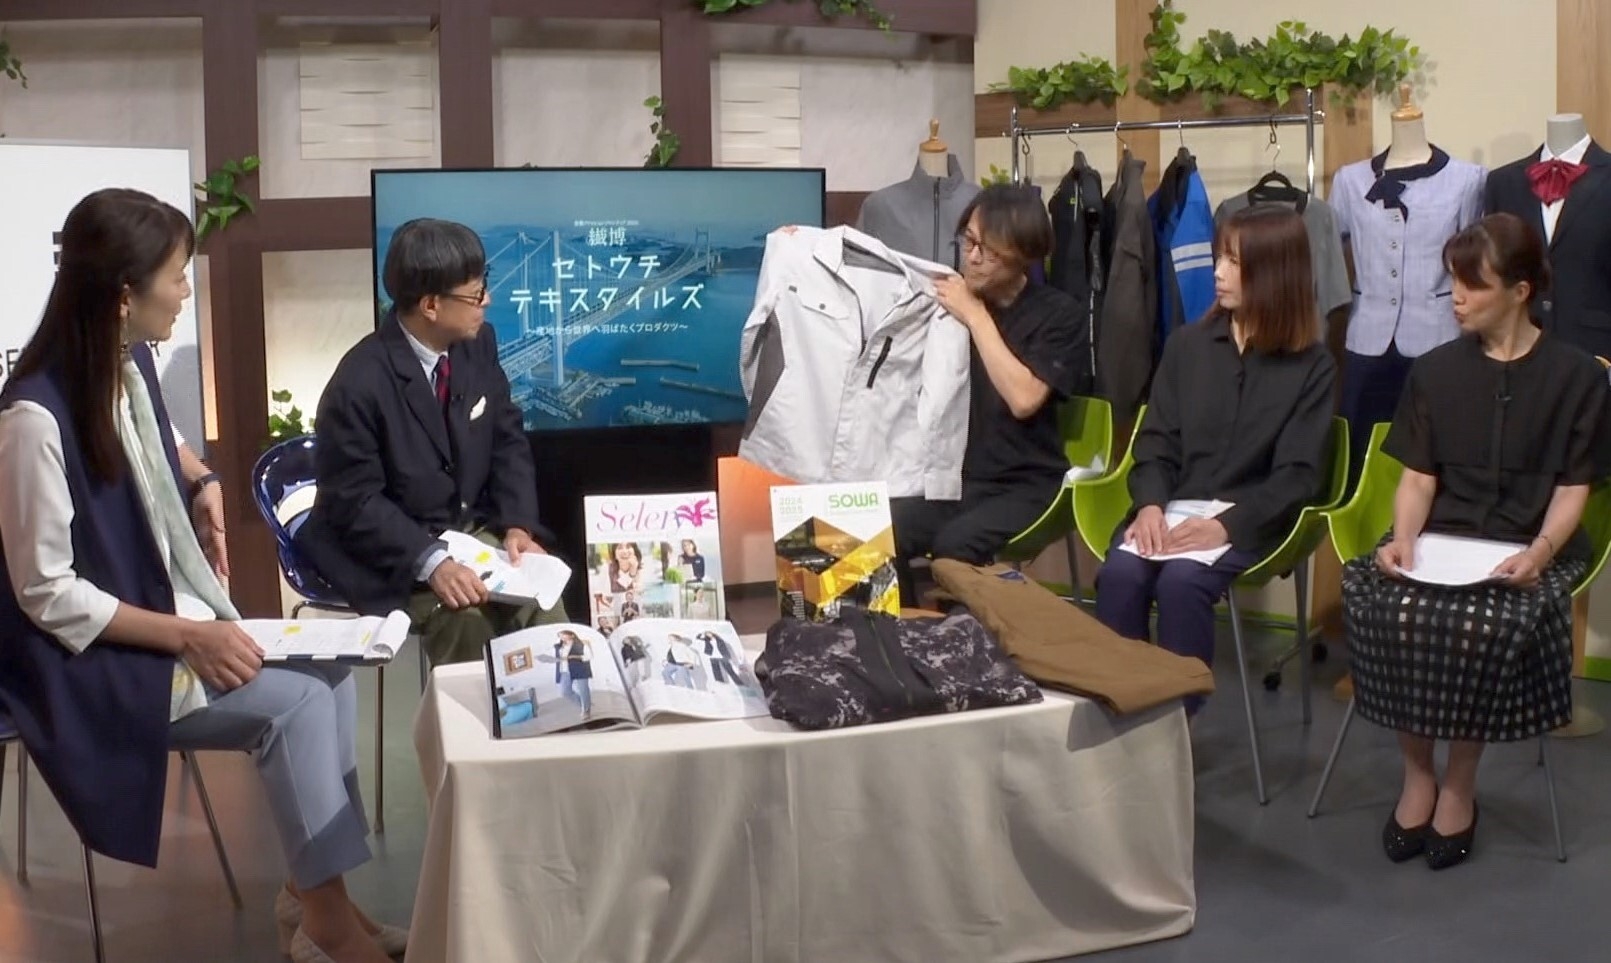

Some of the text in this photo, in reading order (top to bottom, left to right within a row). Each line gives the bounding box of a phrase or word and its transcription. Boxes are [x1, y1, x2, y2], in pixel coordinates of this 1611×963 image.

[552, 254, 661, 280] セトウチ
[510, 283, 704, 314] テキスタイルズ
[827, 492, 879, 509] SOWA
